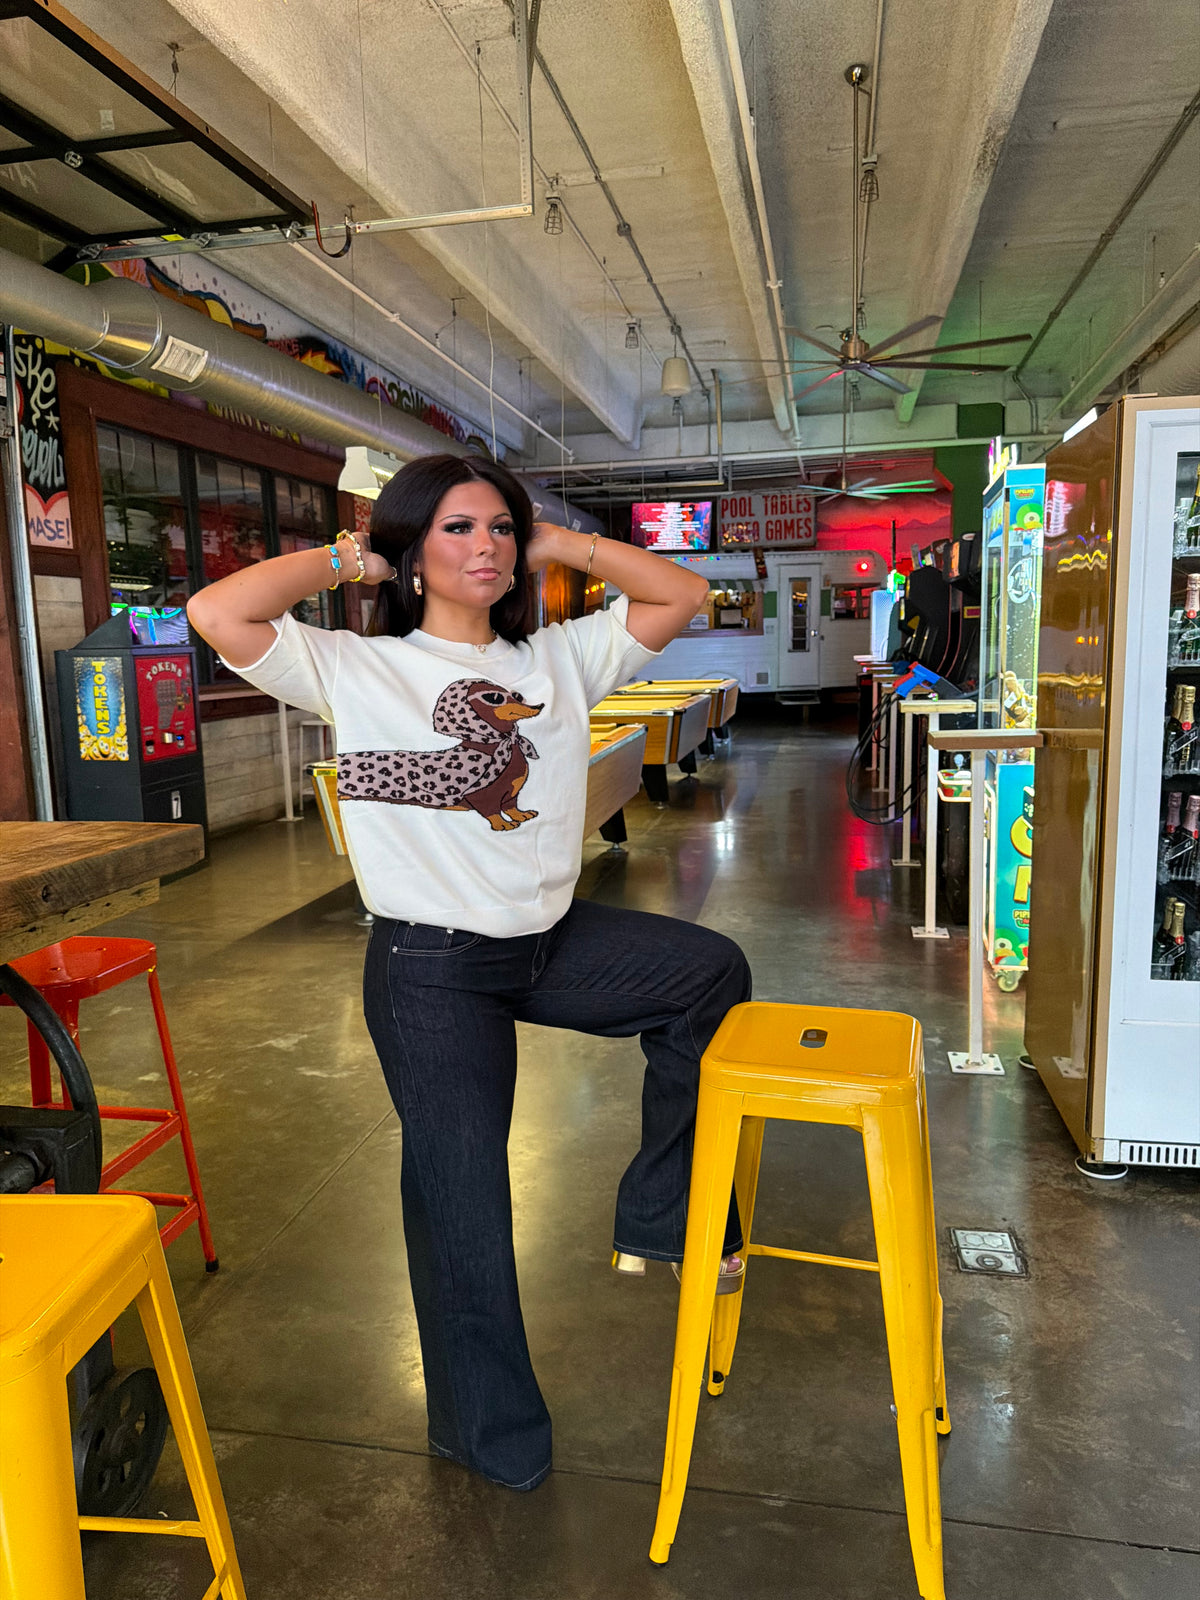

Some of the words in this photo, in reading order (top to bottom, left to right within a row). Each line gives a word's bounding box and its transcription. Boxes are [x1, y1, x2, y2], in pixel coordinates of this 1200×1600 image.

[721, 496, 755, 519] POOL
[762, 494, 811, 516] TABLES
[765, 517, 812, 541] GAMES
[146, 661, 182, 682] TOKENS
[91, 661, 111, 735] TOKENS
